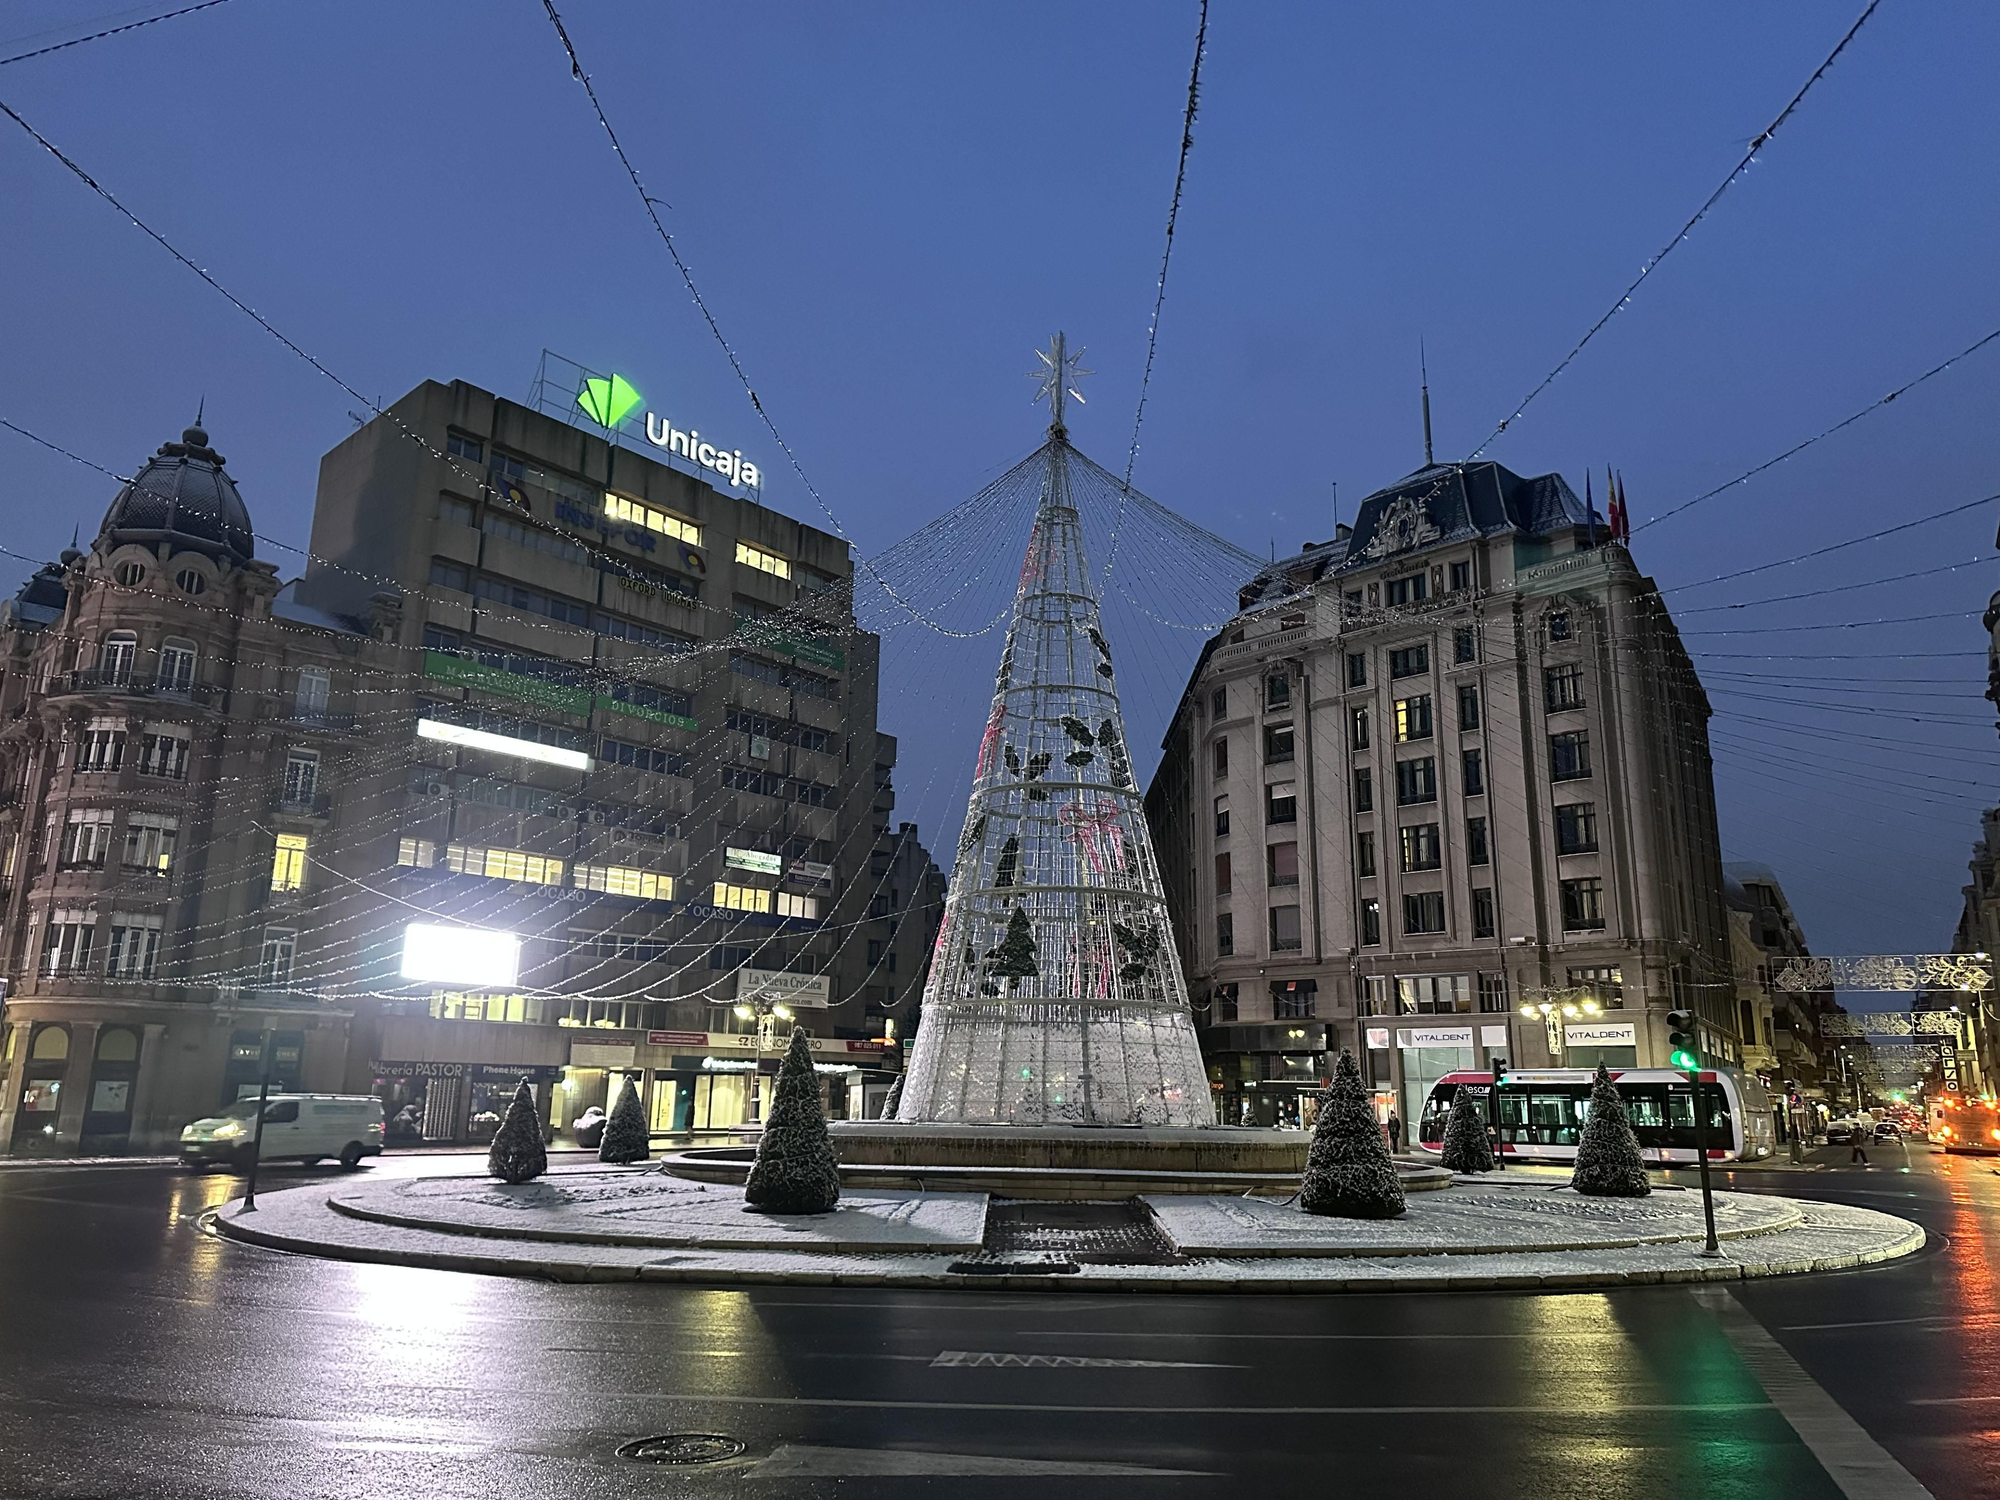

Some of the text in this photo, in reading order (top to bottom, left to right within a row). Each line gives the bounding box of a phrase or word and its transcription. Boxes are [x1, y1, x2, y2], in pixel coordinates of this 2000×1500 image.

[645, 411, 759, 487] Unicaja
[620, 577, 698, 610] OXFORD IDIOMAS
[611, 699, 685, 727] DIVORCIOS
[536, 886, 587, 903] OCASO
[693, 905, 734, 921] OCASO
[748, 972, 822, 990] La Nueva Crónica
[1414, 1033, 1471, 1042] VITALDENT
[1568, 1030, 1633, 1040] VITALDENT
[415, 1062, 463, 1077] PASTOR
[483, 1065, 536, 1075] Phone House
